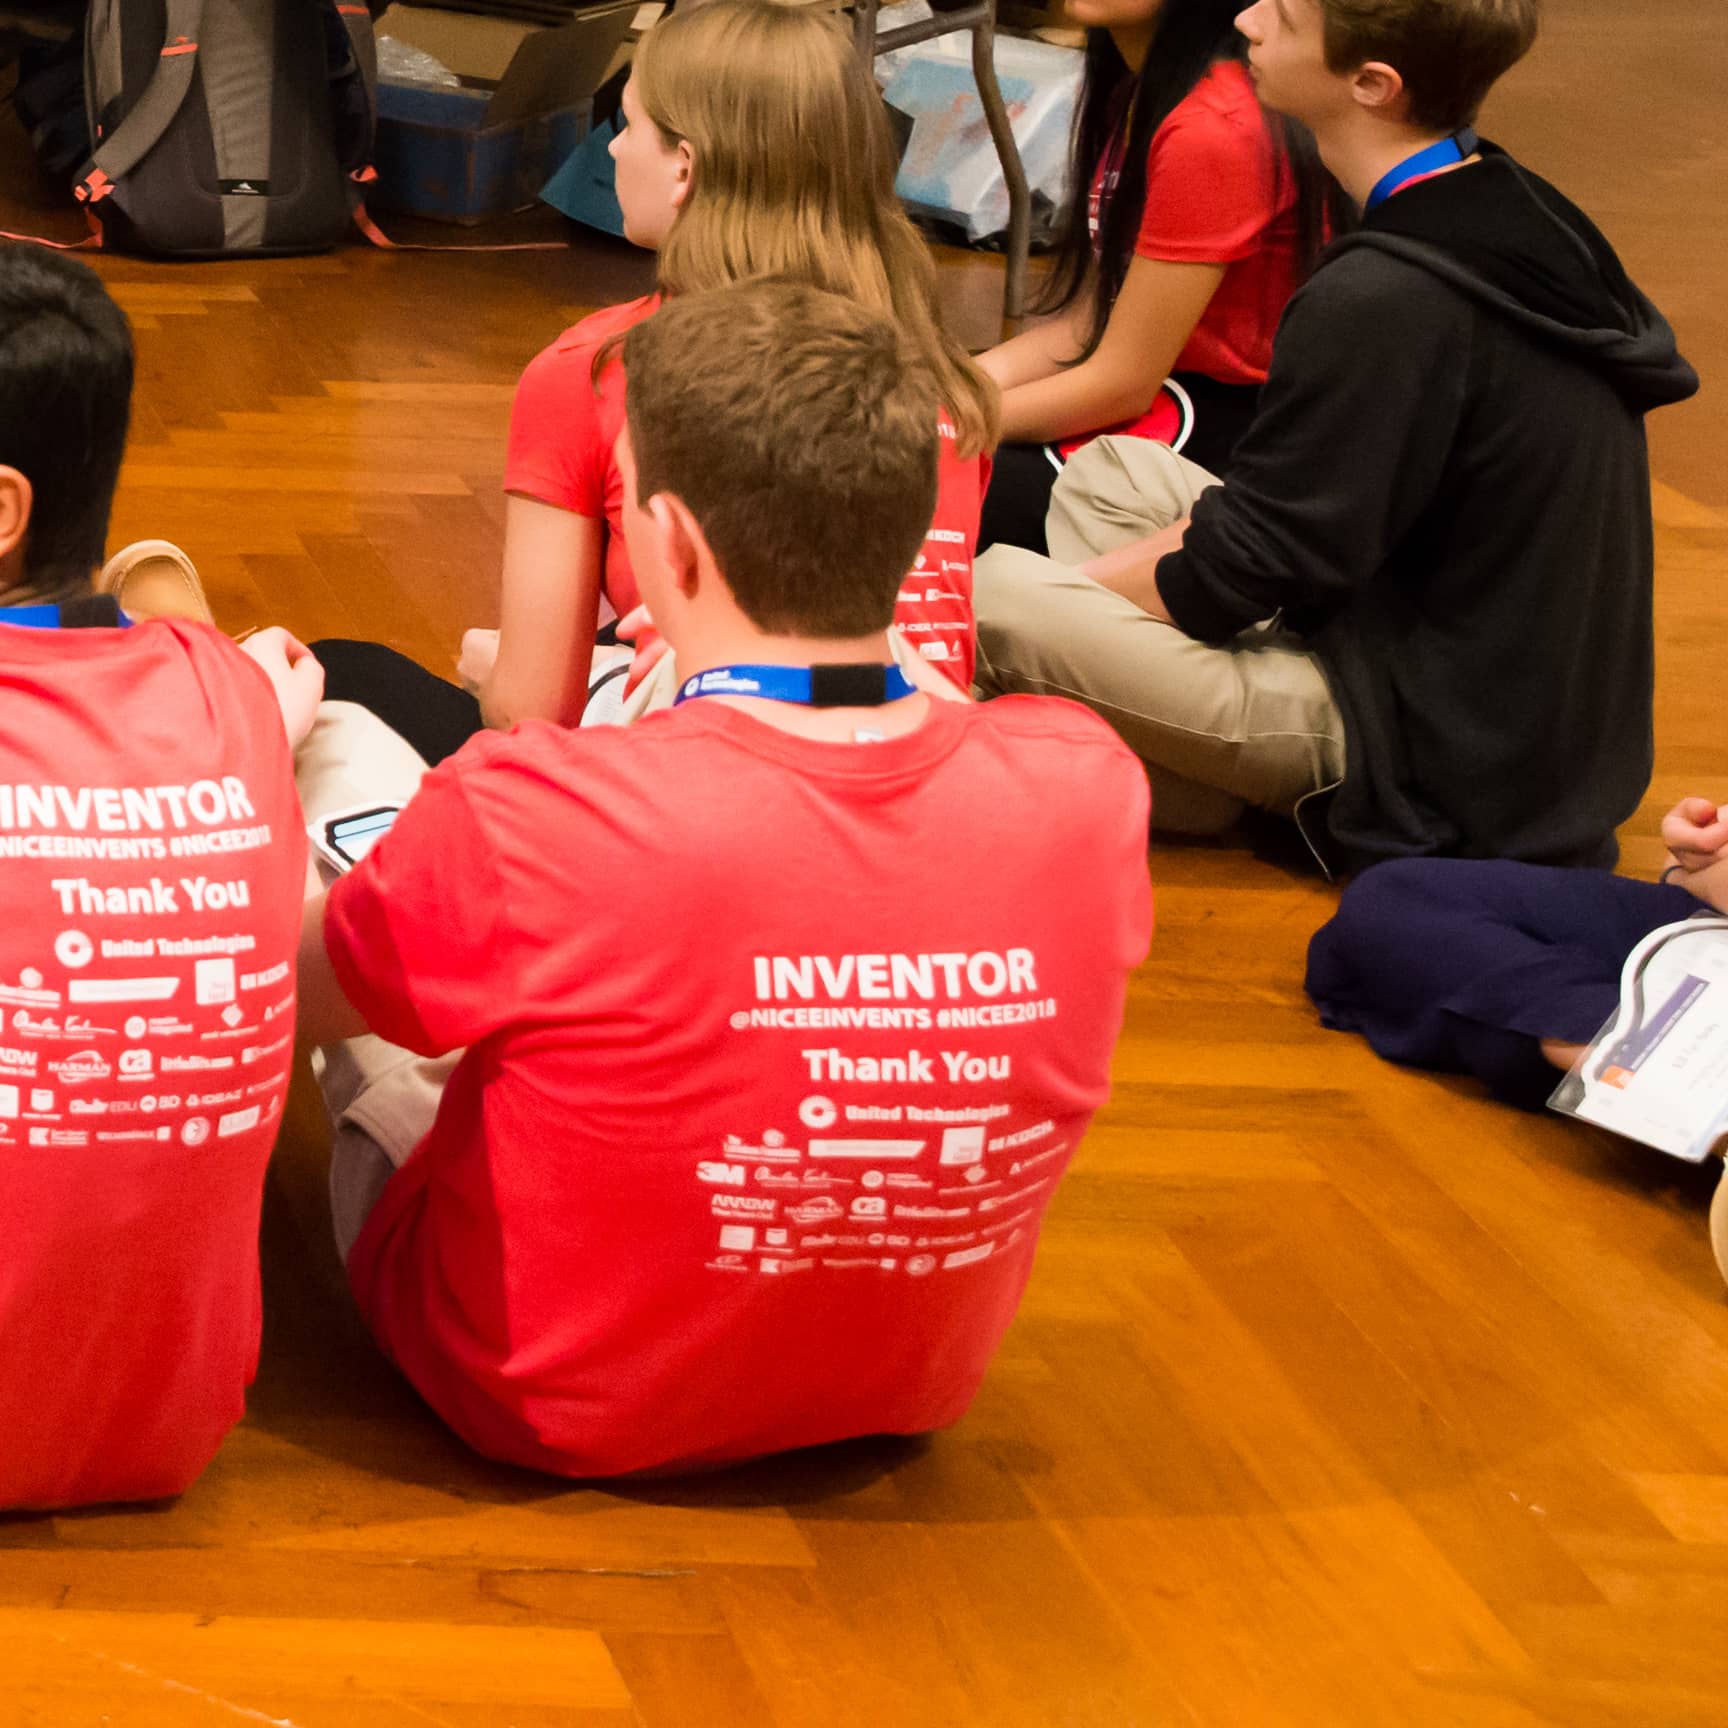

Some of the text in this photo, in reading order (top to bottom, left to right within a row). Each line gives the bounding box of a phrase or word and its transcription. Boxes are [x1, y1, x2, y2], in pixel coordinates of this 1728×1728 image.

[51, 876, 250, 915] Thank You
[101, 939, 154, 958] United
[754, 948, 1038, 1000] INVENTOR
[729, 998, 1056, 1030] @NICEEINVENTS #NICEE2018
[801, 1048, 1010, 1082] Thank You
[844, 1106, 902, 1121] United
[696, 1161, 746, 1186] 3M
